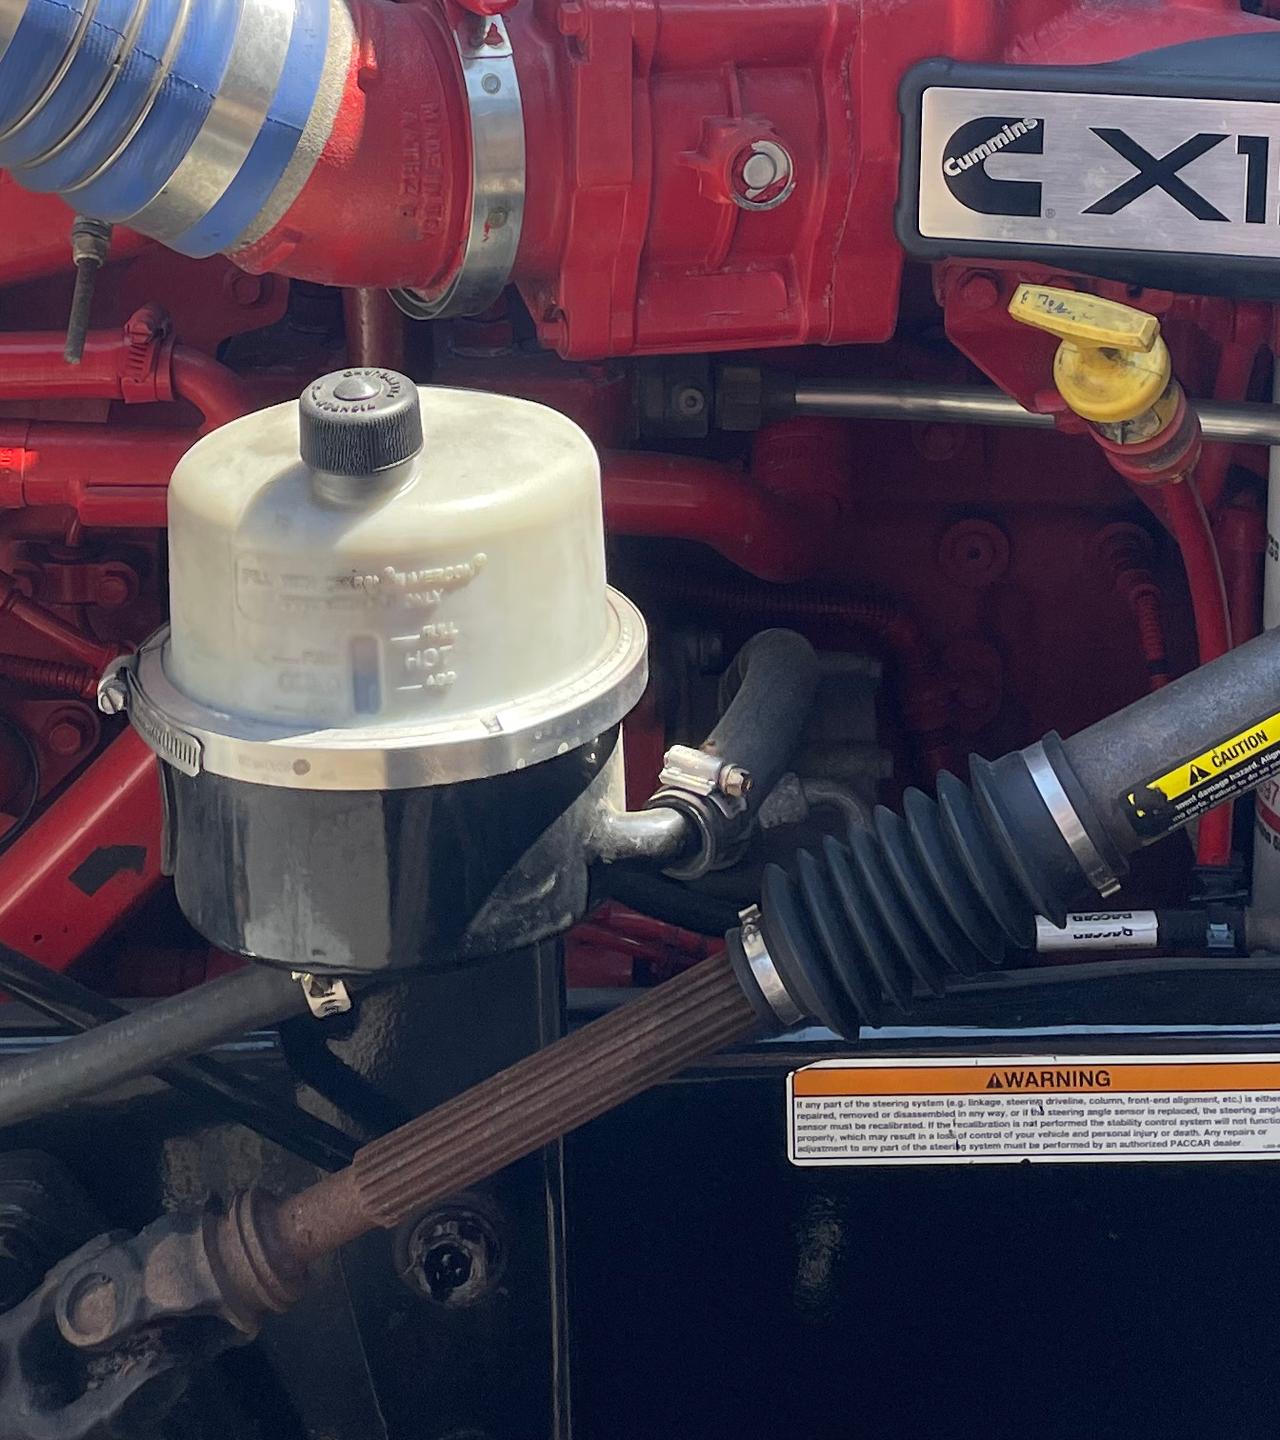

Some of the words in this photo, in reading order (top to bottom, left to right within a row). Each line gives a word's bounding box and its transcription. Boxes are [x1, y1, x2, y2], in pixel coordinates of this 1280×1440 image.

[943, 117, 1038, 177] Cummins
[405, 645, 453, 672] HOT
[1211, 730, 1269, 768] CAUTION
[1197, 778, 1230, 801] damage
[1230, 762, 1259, 783] hazard.
[1004, 1070, 1111, 1087] WARNING
[823, 1101, 842, 1110] part
[872, 1100, 909, 1109] steering
[912, 1100, 944, 1108] system
[946, 1099, 966, 1108] (e.g.
[968, 1098, 1004, 1107] linkage,
[1046, 1097, 1087, 1106] driveline,
[1089, 1097, 1126, 1105] column,
[1128, 1096, 1170, 1104] front-end
[1172, 1096, 1220, 1105] alignment,
[1222, 1095, 1243, 1104] etc.)
[1255, 1095, 1280, 1103] either
[797, 1111, 837, 1120] repaired,
[839, 1111, 879, 1119] removed
[894, 1110, 956, 1119] disassembled
[1048, 1109, 1085, 1117] steering
[1087, 1108, 1111, 1117] angle
[1158, 1107, 1200, 1116] replaced,
[1220, 1107, 1257, 1115] steering
[797, 1123, 827, 1131] sensor
[869, 1121, 926, 1129] recalibrated.
[1040, 1119, 1088, 1128] performed
[1107, 1118, 1142, 1127] stability
[1144, 1118, 1177, 1126] control
[1179, 1118, 1212, 1126] system
[1214, 1117, 1230, 1125] will
[797, 1133, 838, 1143] properly,
[839, 1133, 866, 1141] which
[970, 1131, 1002, 1139] control
[1015, 1131, 1035, 1140] your
[1038, 1130, 1069, 1138] vehicle
[1092, 1130, 1131, 1139] personal
[1133, 1129, 1159, 1138] injury
[1173, 1128, 1201, 1137] death.
[1223, 1128, 1255, 1137] repairs
[797, 1144, 848, 1154] adjustment
[880, 1144, 899, 1153] part
[969, 1143, 1001, 1151] system
[1043, 1141, 1090, 1150] performed
[1120, 1140, 1168, 1148] authorized
[1170, 1139, 1211, 1147] PACCAR
